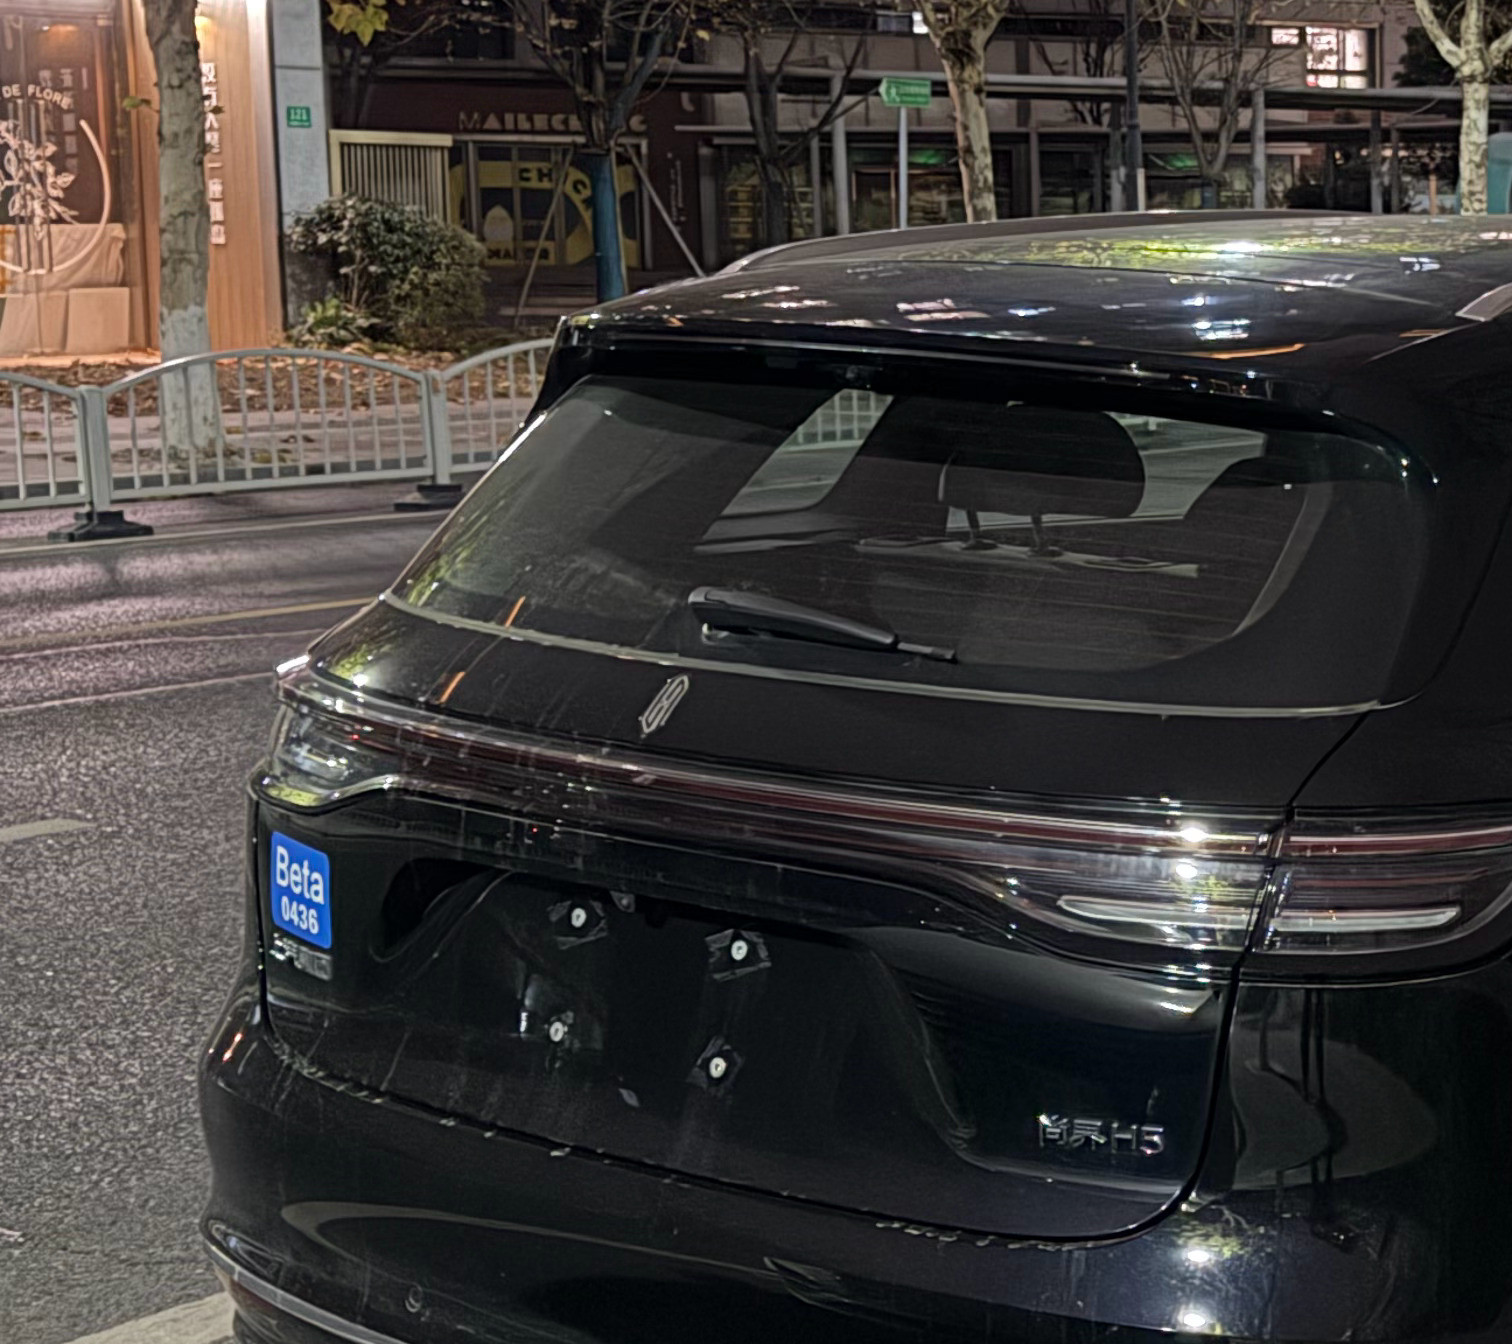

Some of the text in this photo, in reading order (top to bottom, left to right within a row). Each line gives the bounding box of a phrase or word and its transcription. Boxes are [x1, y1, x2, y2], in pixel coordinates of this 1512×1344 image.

[2, 84, 21, 98] DE
[275, 845, 324, 905] Beta
[281, 895, 319, 935] 0436
